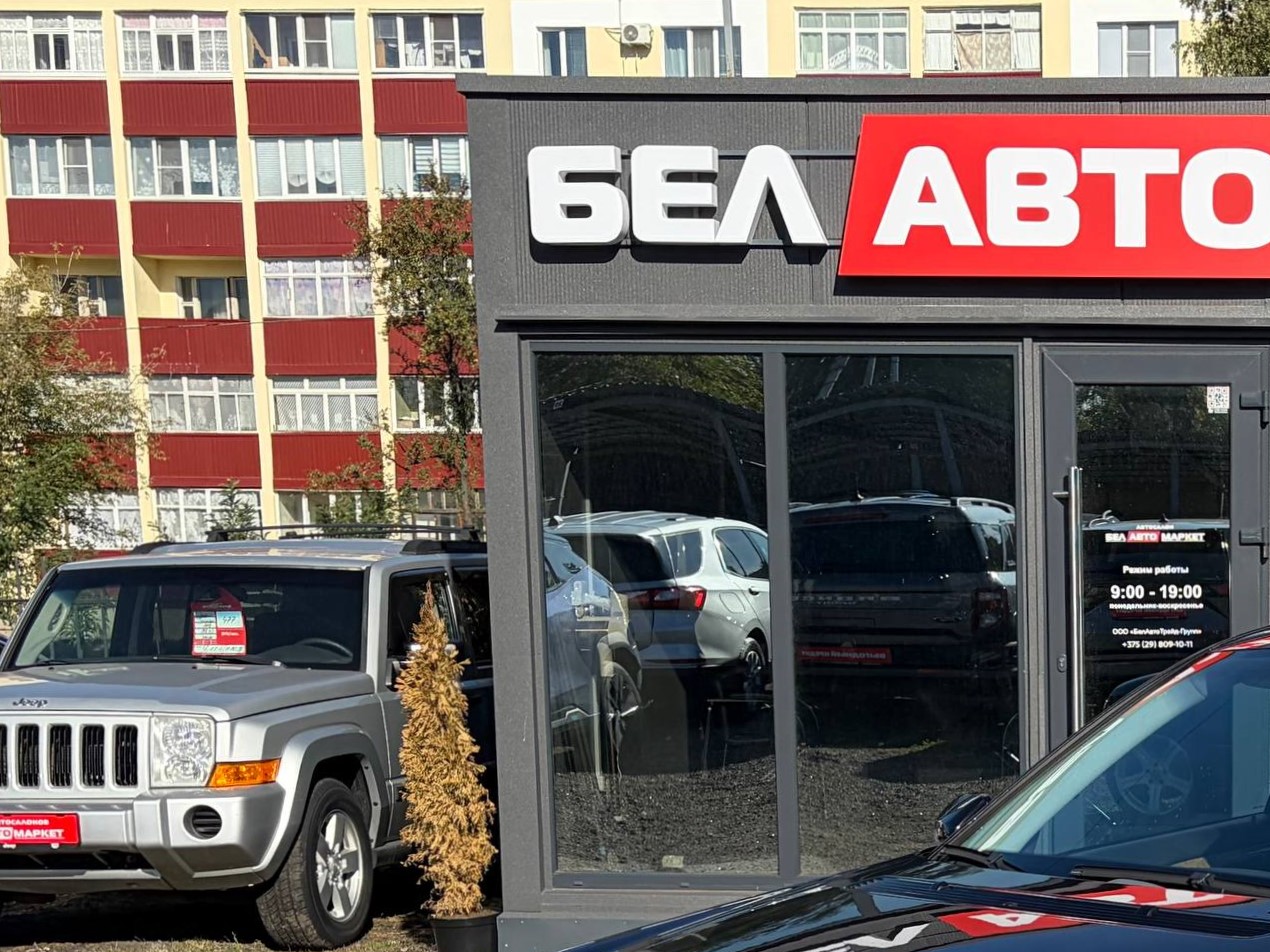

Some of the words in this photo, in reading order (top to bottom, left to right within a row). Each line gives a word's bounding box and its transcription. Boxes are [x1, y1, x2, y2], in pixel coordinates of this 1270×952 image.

[527, 144, 828, 245] БЕЛ
[1105, 533, 1126, 542] БЕЛ
[1129, 533, 1157, 541] АВТО
[1160, 533, 1206, 542] МАРКЕТ
[1122, 565, 1152, 574] Режим
[1154, 565, 1189, 576] работы
[1110, 585, 1145, 599] 9:00
[1159, 585, 1202, 599] 19:00
[1142, 640, 1157, 648] (29)
[12, 697, 48, 708] Jeep
[13, 829, 64, 838] МАРКЕТ
